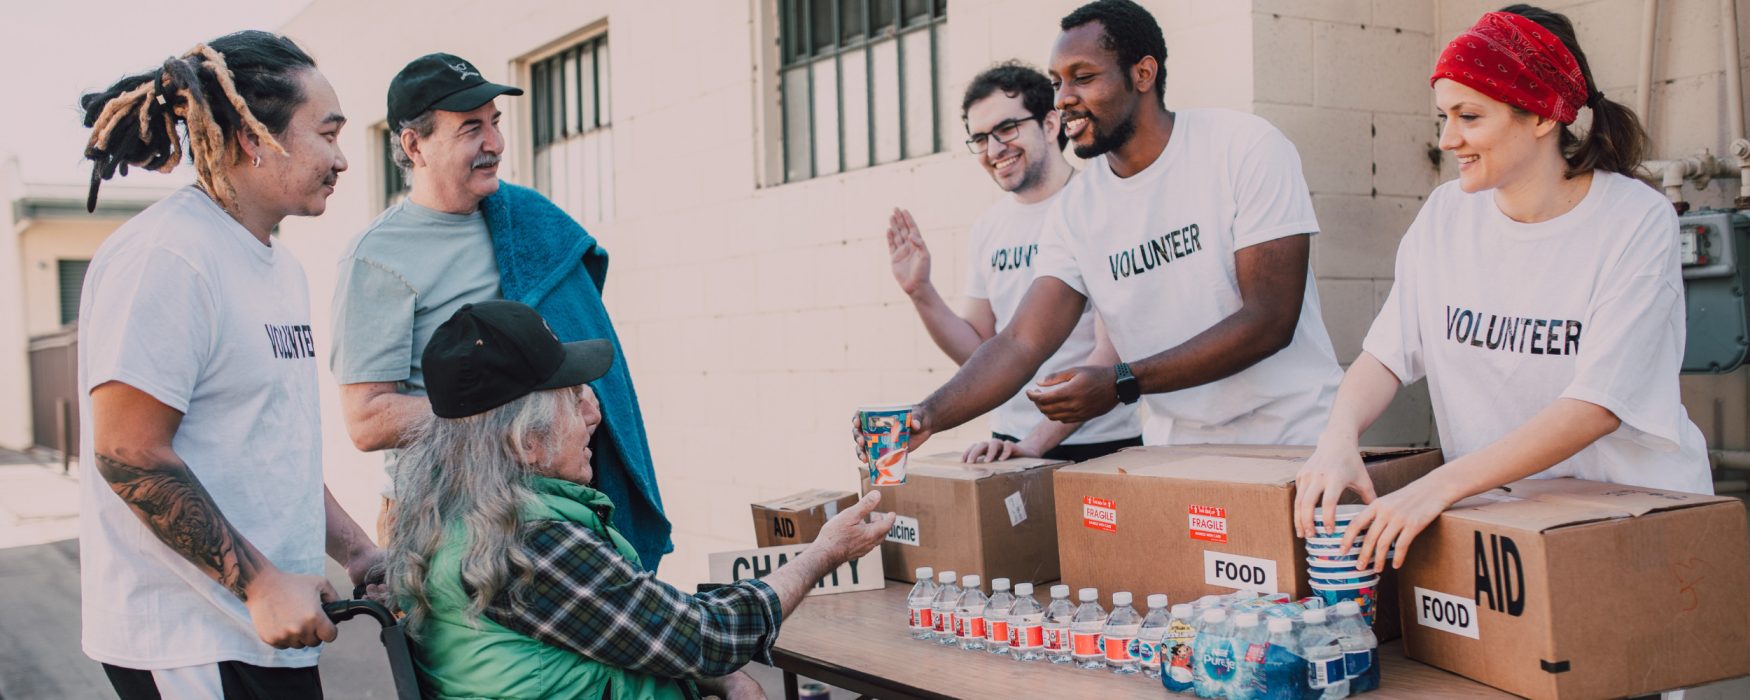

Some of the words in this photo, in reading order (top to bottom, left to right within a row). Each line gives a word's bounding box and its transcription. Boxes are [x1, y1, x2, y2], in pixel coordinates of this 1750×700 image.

[1108, 223, 1202, 281] VOLUNTEER
[1446, 305, 1583, 356] VOLUNTEER
[773, 516, 795, 538] AID
[1086, 508, 1114, 521] FRAGILE
[1192, 517, 1224, 531] FRAGILE
[1215, 560, 1266, 585] FOOD
[1474, 530, 1525, 617] AID
[1422, 595, 1469, 628] FOOD
